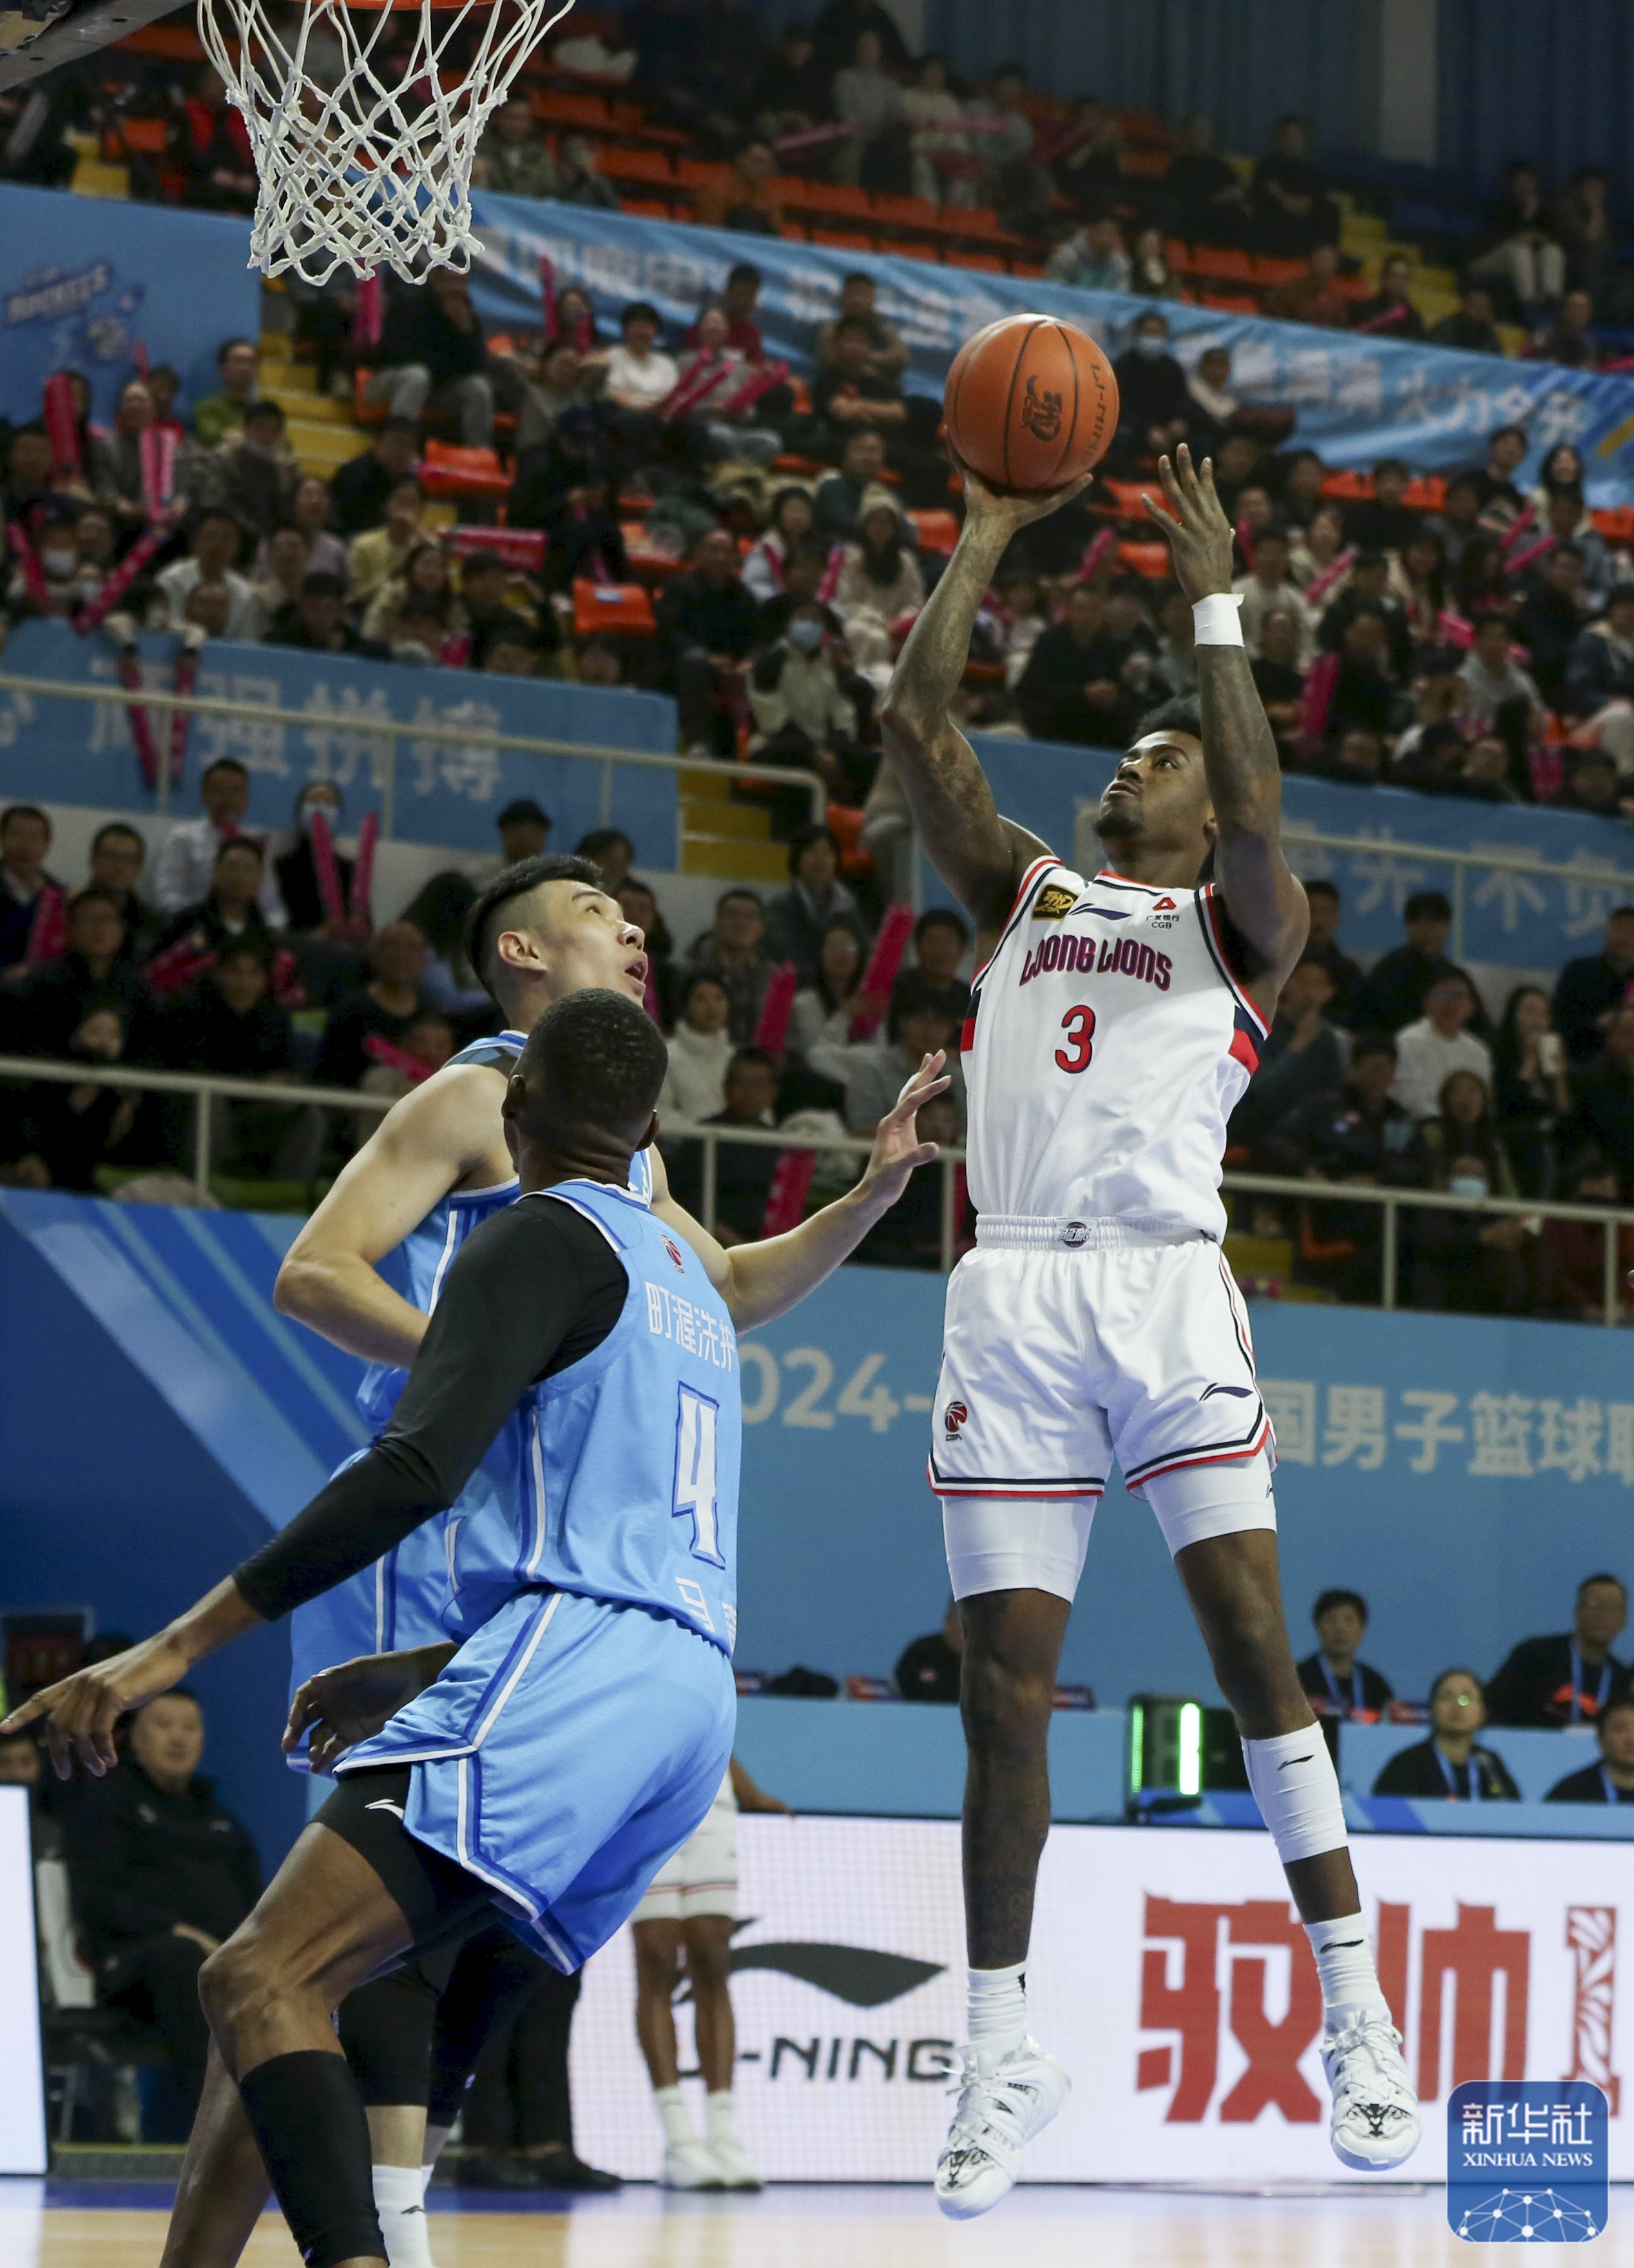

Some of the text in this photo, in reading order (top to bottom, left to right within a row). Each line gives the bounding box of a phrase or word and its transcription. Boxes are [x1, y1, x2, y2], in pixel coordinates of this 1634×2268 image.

[1097, 937, 1172, 991] LIONS
[1055, 1004, 1096, 1073] 3
[671, 1379, 726, 1571] 4
